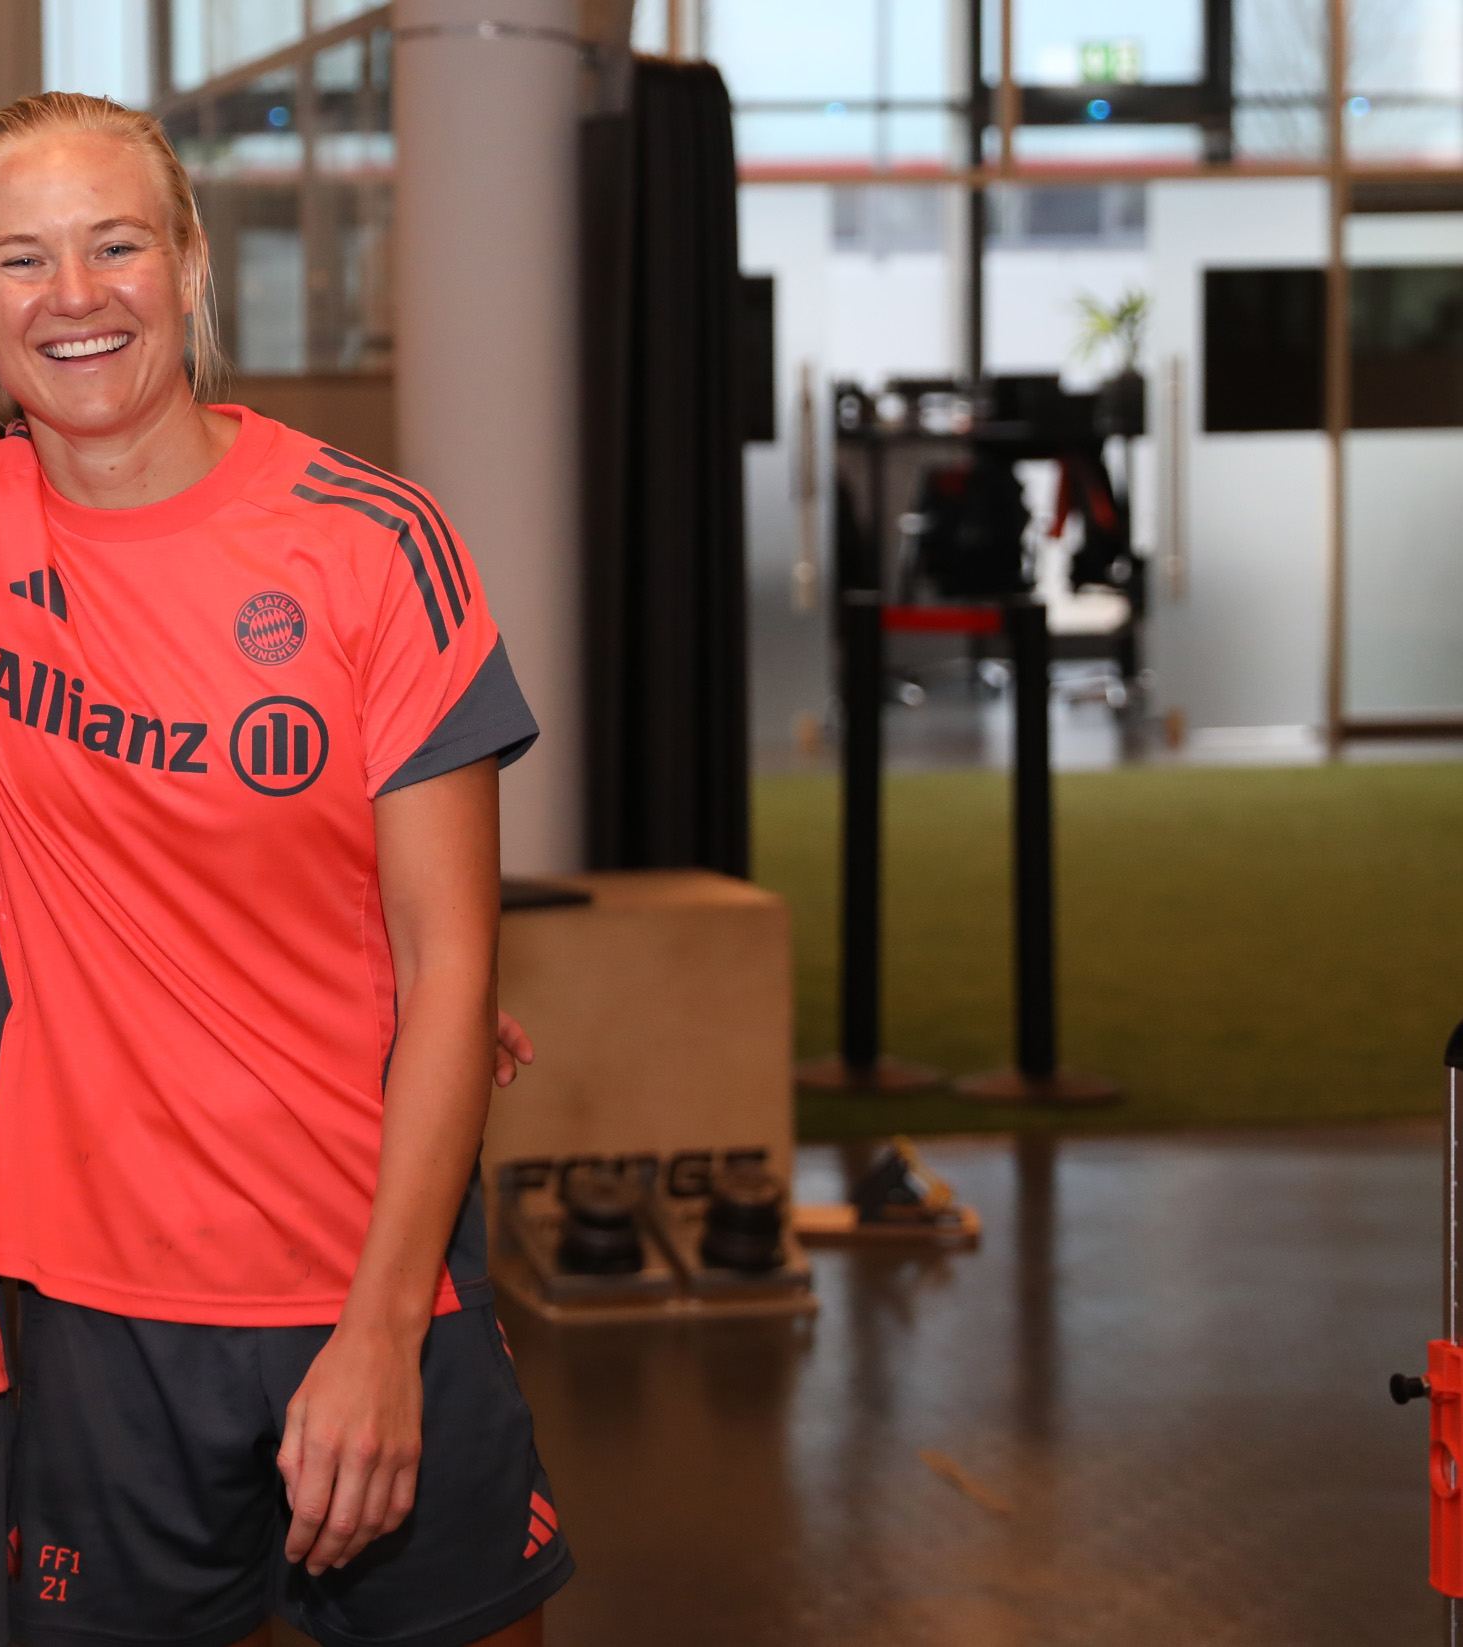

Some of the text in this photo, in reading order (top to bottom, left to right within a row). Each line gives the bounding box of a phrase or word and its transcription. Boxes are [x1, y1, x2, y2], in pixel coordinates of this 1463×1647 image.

[240, 596, 302, 624] FC BAYERN
[39, 1545, 81, 1575] FF1
[39, 1575, 67, 1602] 21
